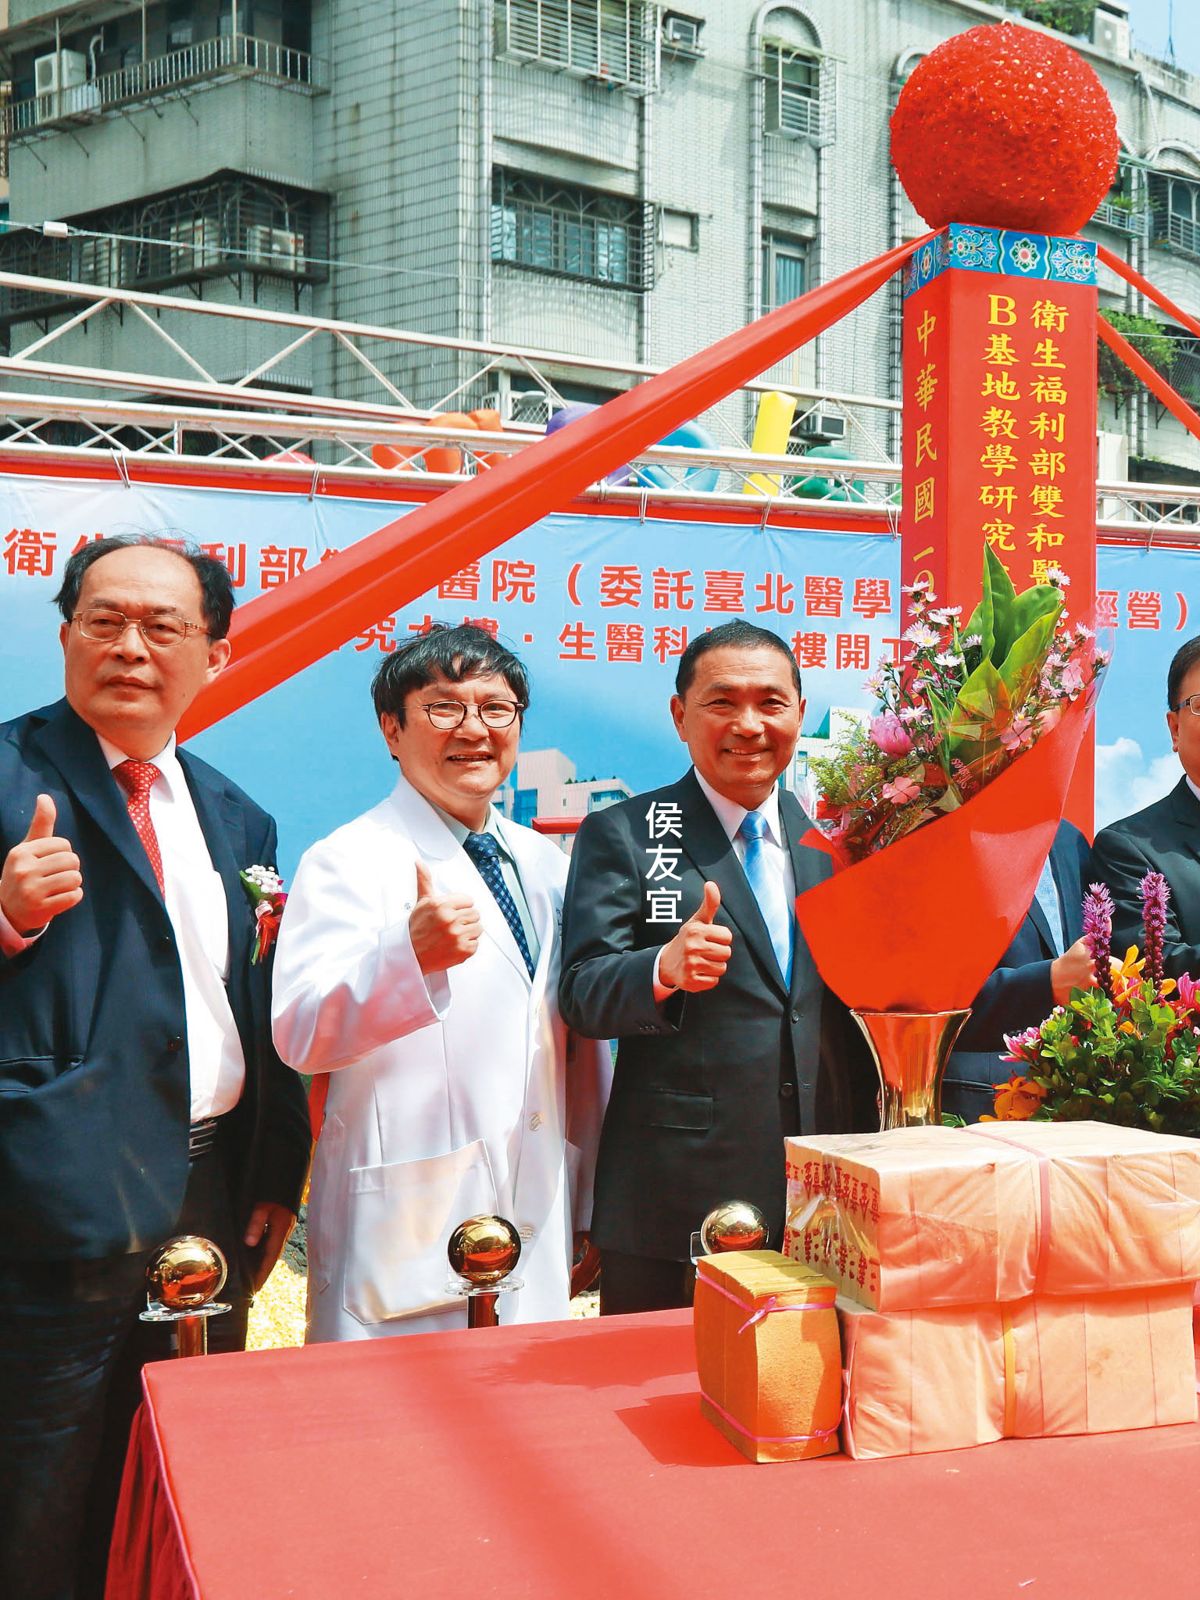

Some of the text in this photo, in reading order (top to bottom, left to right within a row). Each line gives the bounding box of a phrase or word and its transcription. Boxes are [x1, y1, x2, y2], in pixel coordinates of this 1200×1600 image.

[979, 294, 1021, 586] B基地教學研究
